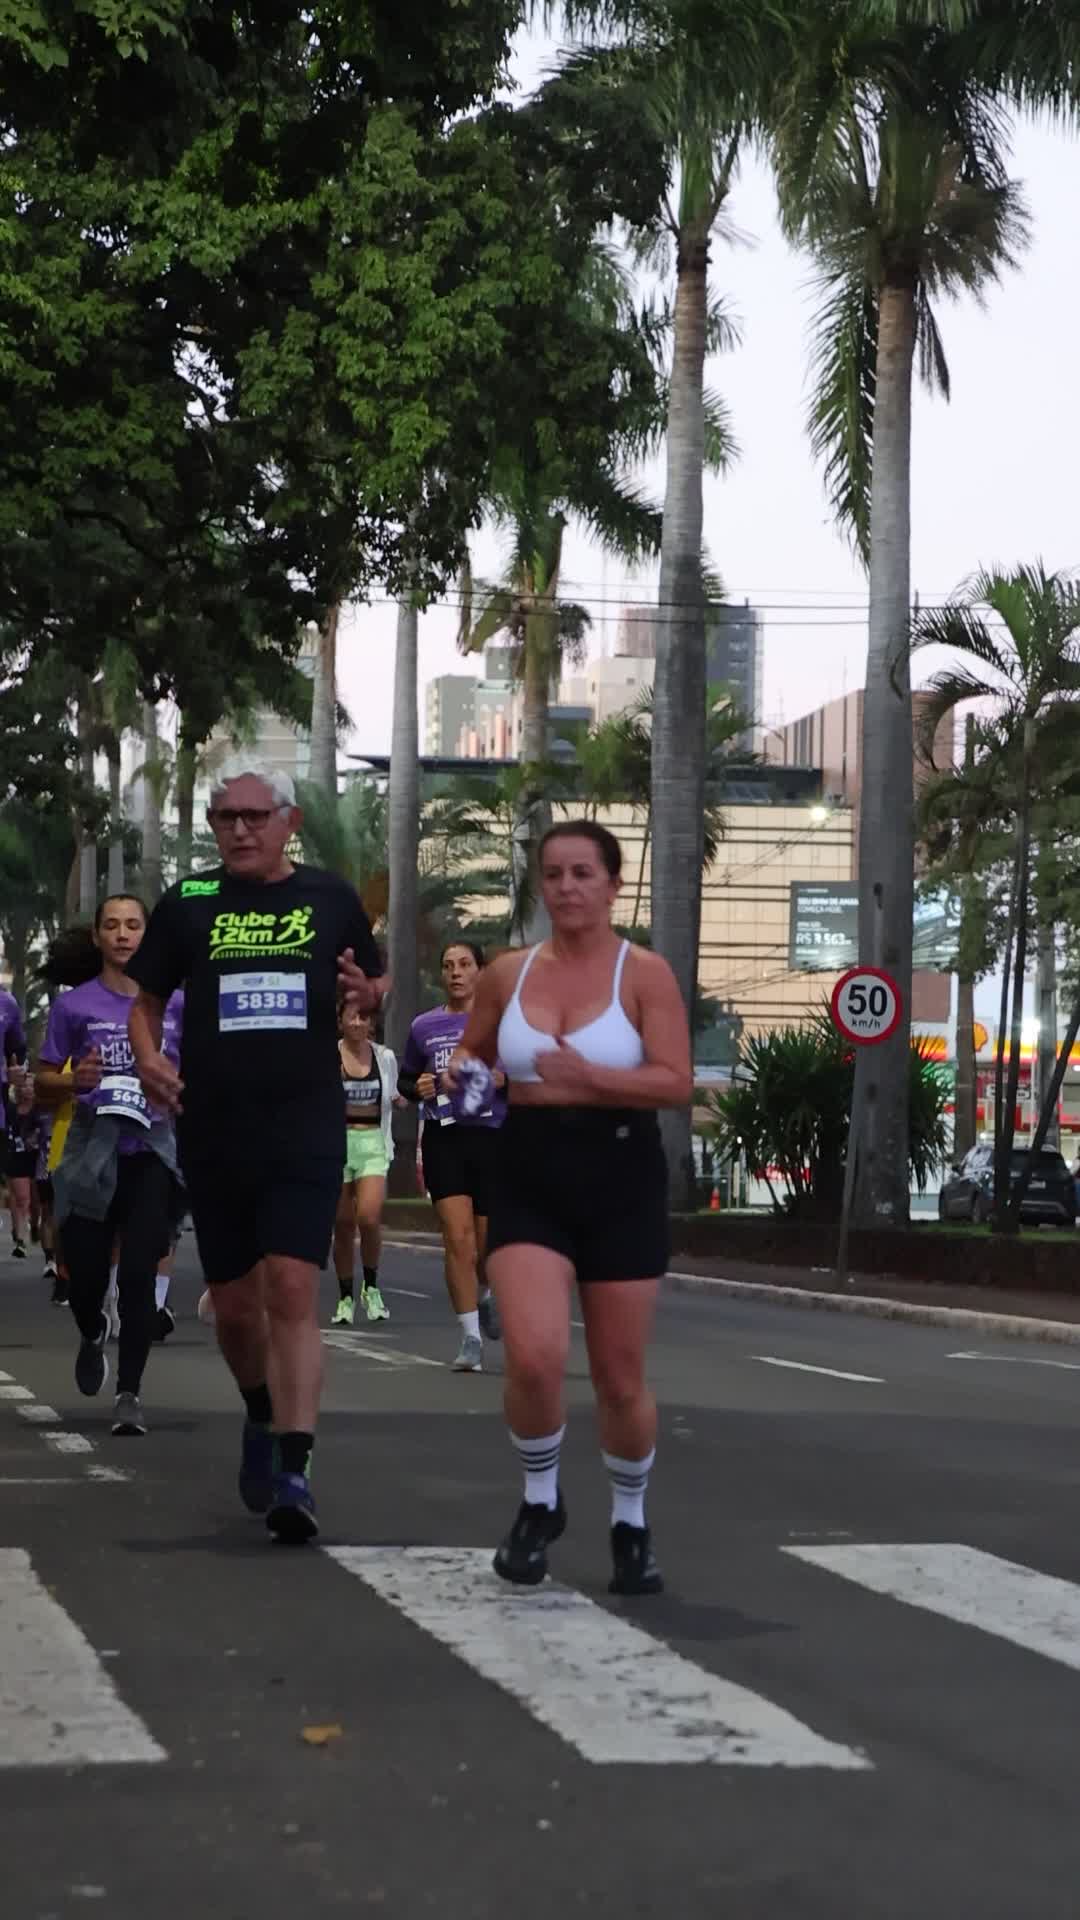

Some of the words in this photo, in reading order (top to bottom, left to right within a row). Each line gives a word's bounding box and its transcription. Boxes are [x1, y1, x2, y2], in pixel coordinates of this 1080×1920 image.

[215, 911, 277, 927] Clube
[209, 927, 274, 945] 12km
[237, 992, 288, 1010] 5838
[847, 984, 888, 1017] 50
[852, 1016, 881, 1029] km/h
[111, 1090, 147, 1110] 5643
